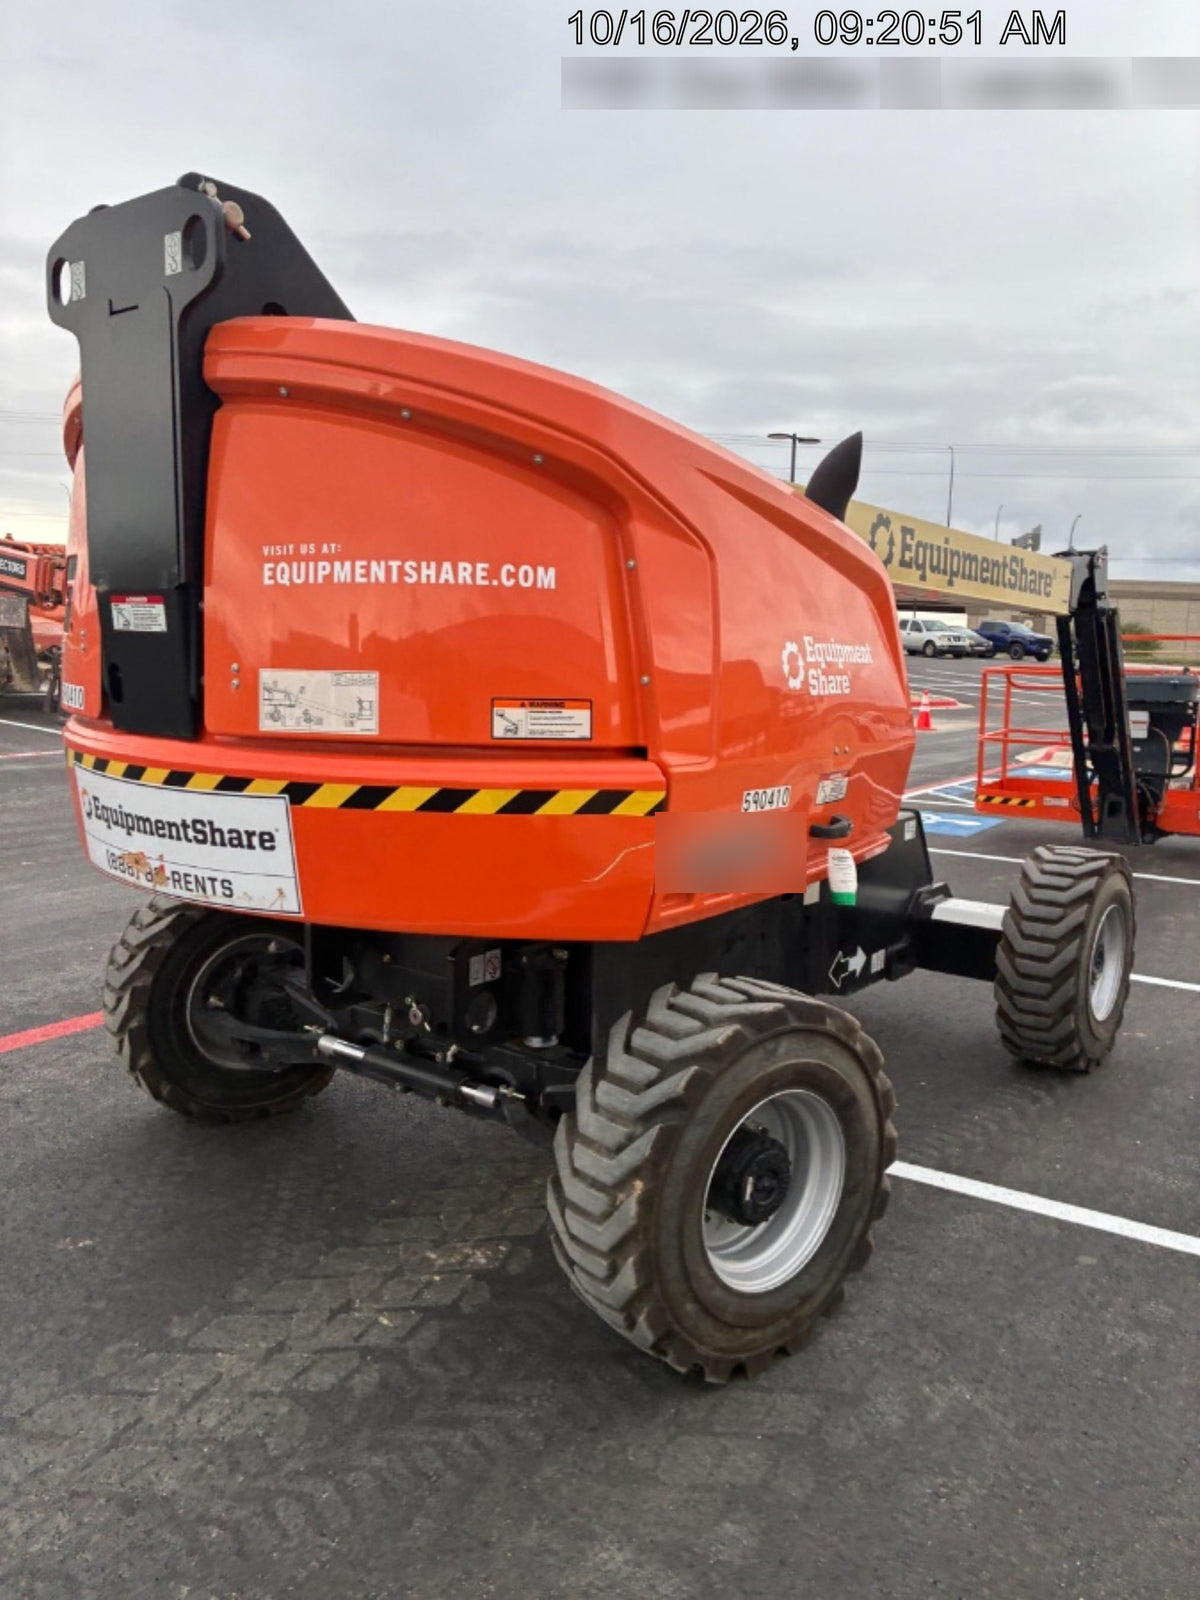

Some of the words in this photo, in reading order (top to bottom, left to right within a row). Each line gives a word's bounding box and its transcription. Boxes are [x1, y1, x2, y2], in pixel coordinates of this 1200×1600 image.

[262, 544, 294, 556] VISIT
[300, 544, 316, 555] US
[321, 544, 342, 554] AT:
[899, 525, 1052, 598] EquipmentShare
[262, 560, 556, 590] EQUIPMENTSHARE.COM
[802, 635, 874, 669] Equipment
[808, 667, 851, 696] Share
[743, 787, 790, 812] 590410
[92, 795, 276, 851] EquipmentShare
